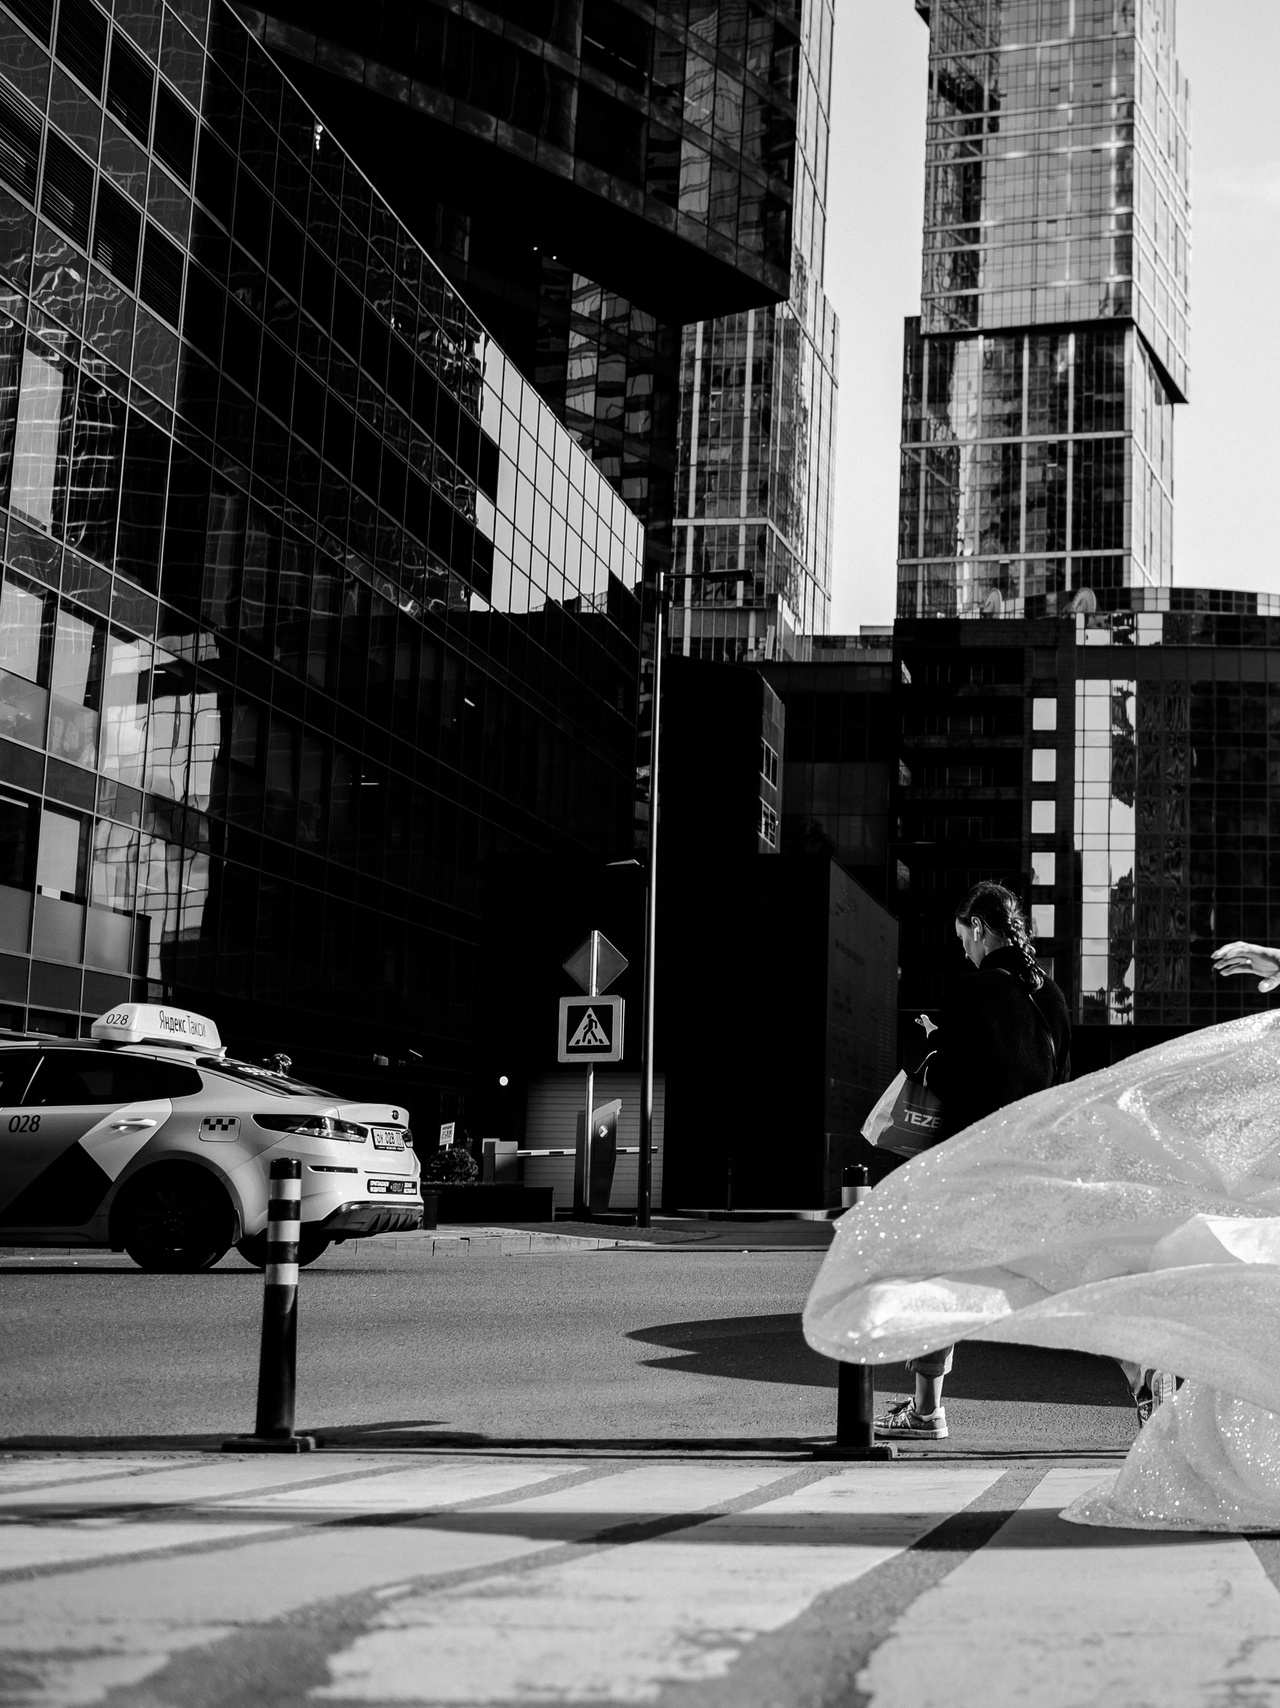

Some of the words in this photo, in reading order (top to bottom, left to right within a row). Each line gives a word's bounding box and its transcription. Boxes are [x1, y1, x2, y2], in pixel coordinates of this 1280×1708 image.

[105, 1013, 129, 1026] 028
[159, 1010, 187, 1034] Яндекс
[186, 1015, 207, 1038] Такси
[8, 1114, 41, 1133] 028
[904, 1108, 942, 1129] TEZE
